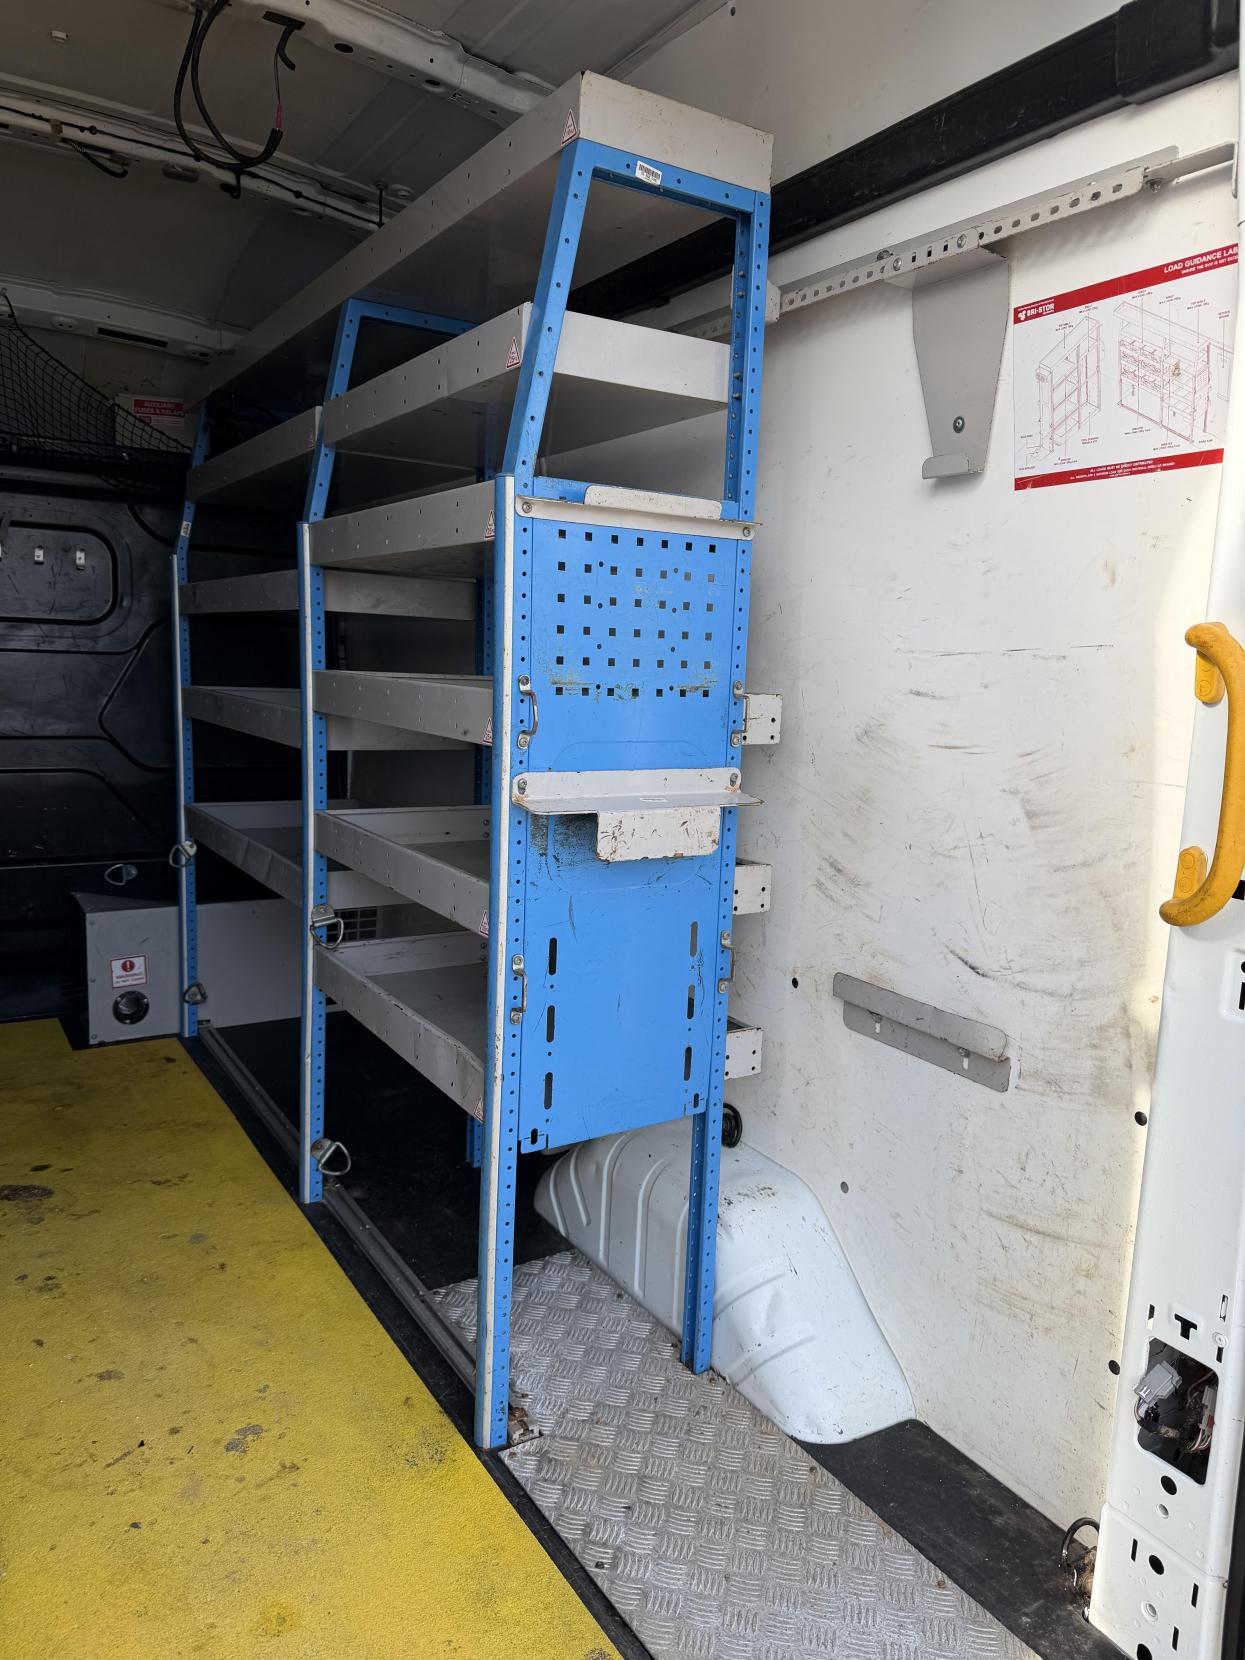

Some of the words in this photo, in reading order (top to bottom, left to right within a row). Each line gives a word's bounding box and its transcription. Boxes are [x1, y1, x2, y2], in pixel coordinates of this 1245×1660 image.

[1164, 262, 1184, 273] LOAD
[1184, 251, 1222, 267] GUIDANCE
[1027, 303, 1055, 316] BRI-STOR
